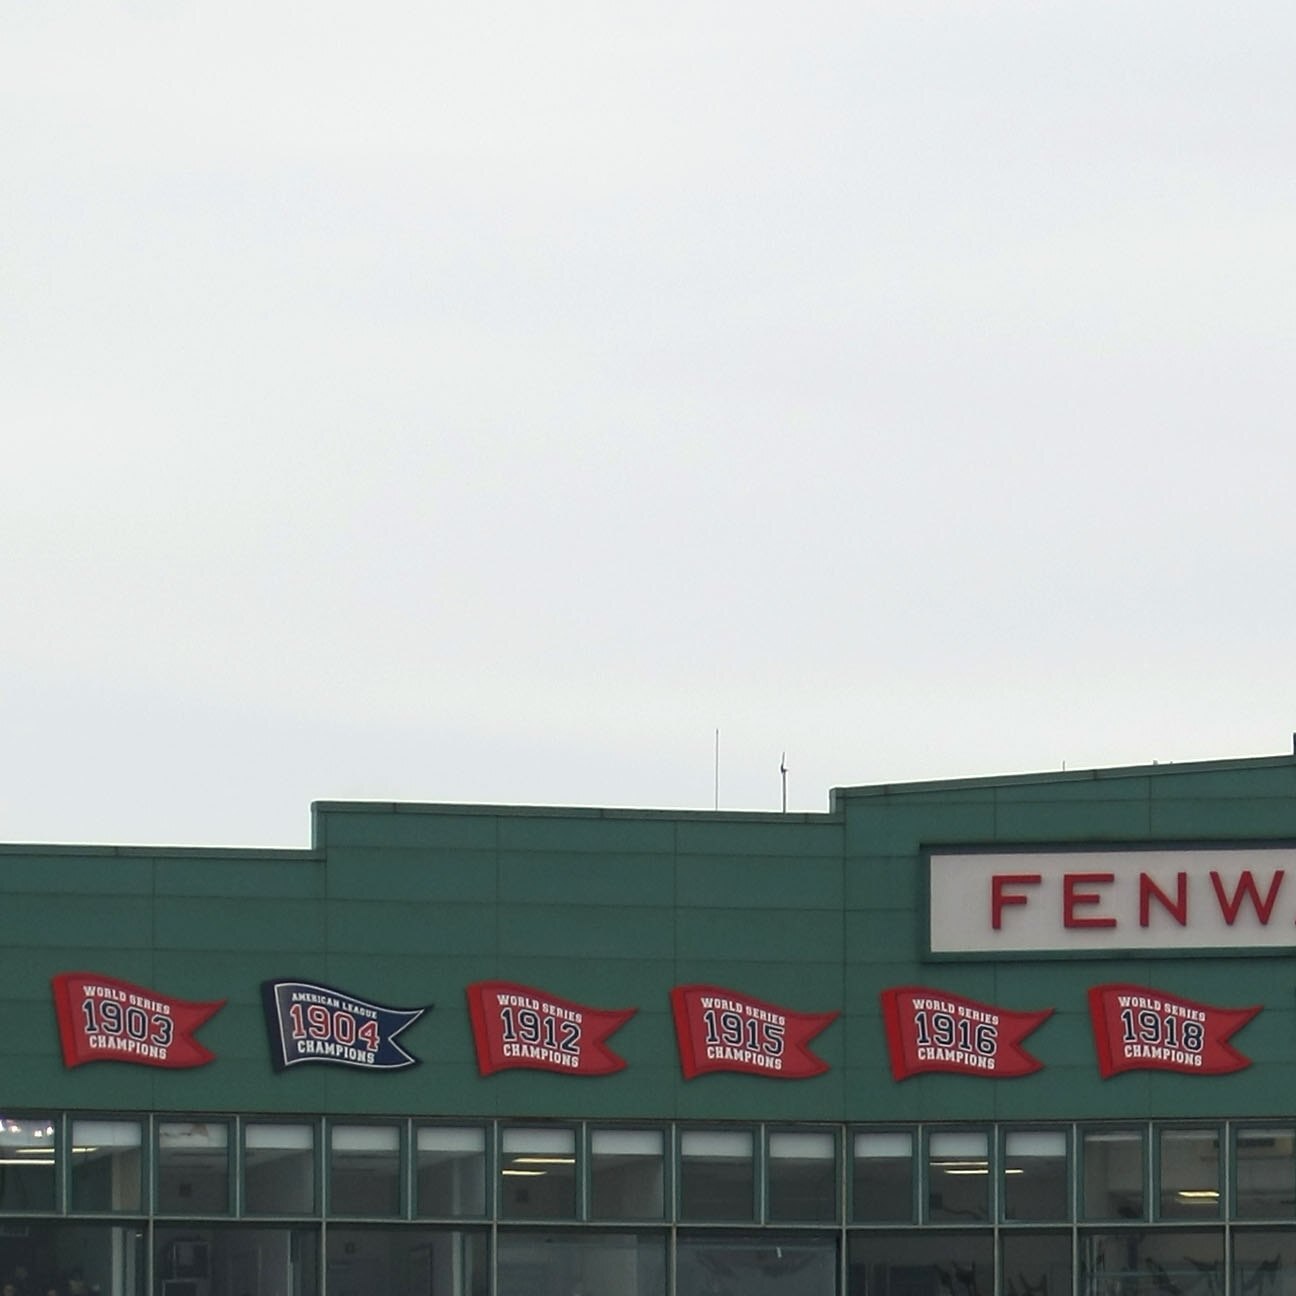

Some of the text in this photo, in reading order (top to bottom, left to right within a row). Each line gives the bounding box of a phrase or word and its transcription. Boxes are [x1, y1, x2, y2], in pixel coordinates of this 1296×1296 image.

[83, 985, 171, 1015] WORLD SERIES
[291, 992, 378, 1020] AMERICAN LEAGUE
[497, 994, 583, 1024] WORLD SERIES
[700, 997, 786, 1026] WORLD SERIES
[912, 998, 999, 1026] WORLD SERIES
[1118, 995, 1206, 1023] WORLD SERIES
[82, 997, 175, 1047] 1903
[289, 1002, 381, 1053] 1904
[500, 1007, 582, 1055] 1912
[702, 1010, 786, 1058] 1915
[914, 1009, 999, 1057] 1916
[1119, 1007, 1206, 1055] 1918
[88, 1034, 169, 1060] CHAMPIONS
[297, 1039, 376, 1065] CHAMPIONS
[503, 1043, 580, 1069] CHAMPIONS
[707, 1046, 783, 1071] CHAMPIONS
[917, 1045, 996, 1070] CHAMPIONS
[1123, 1043, 1203, 1068] CHAMPIONS
